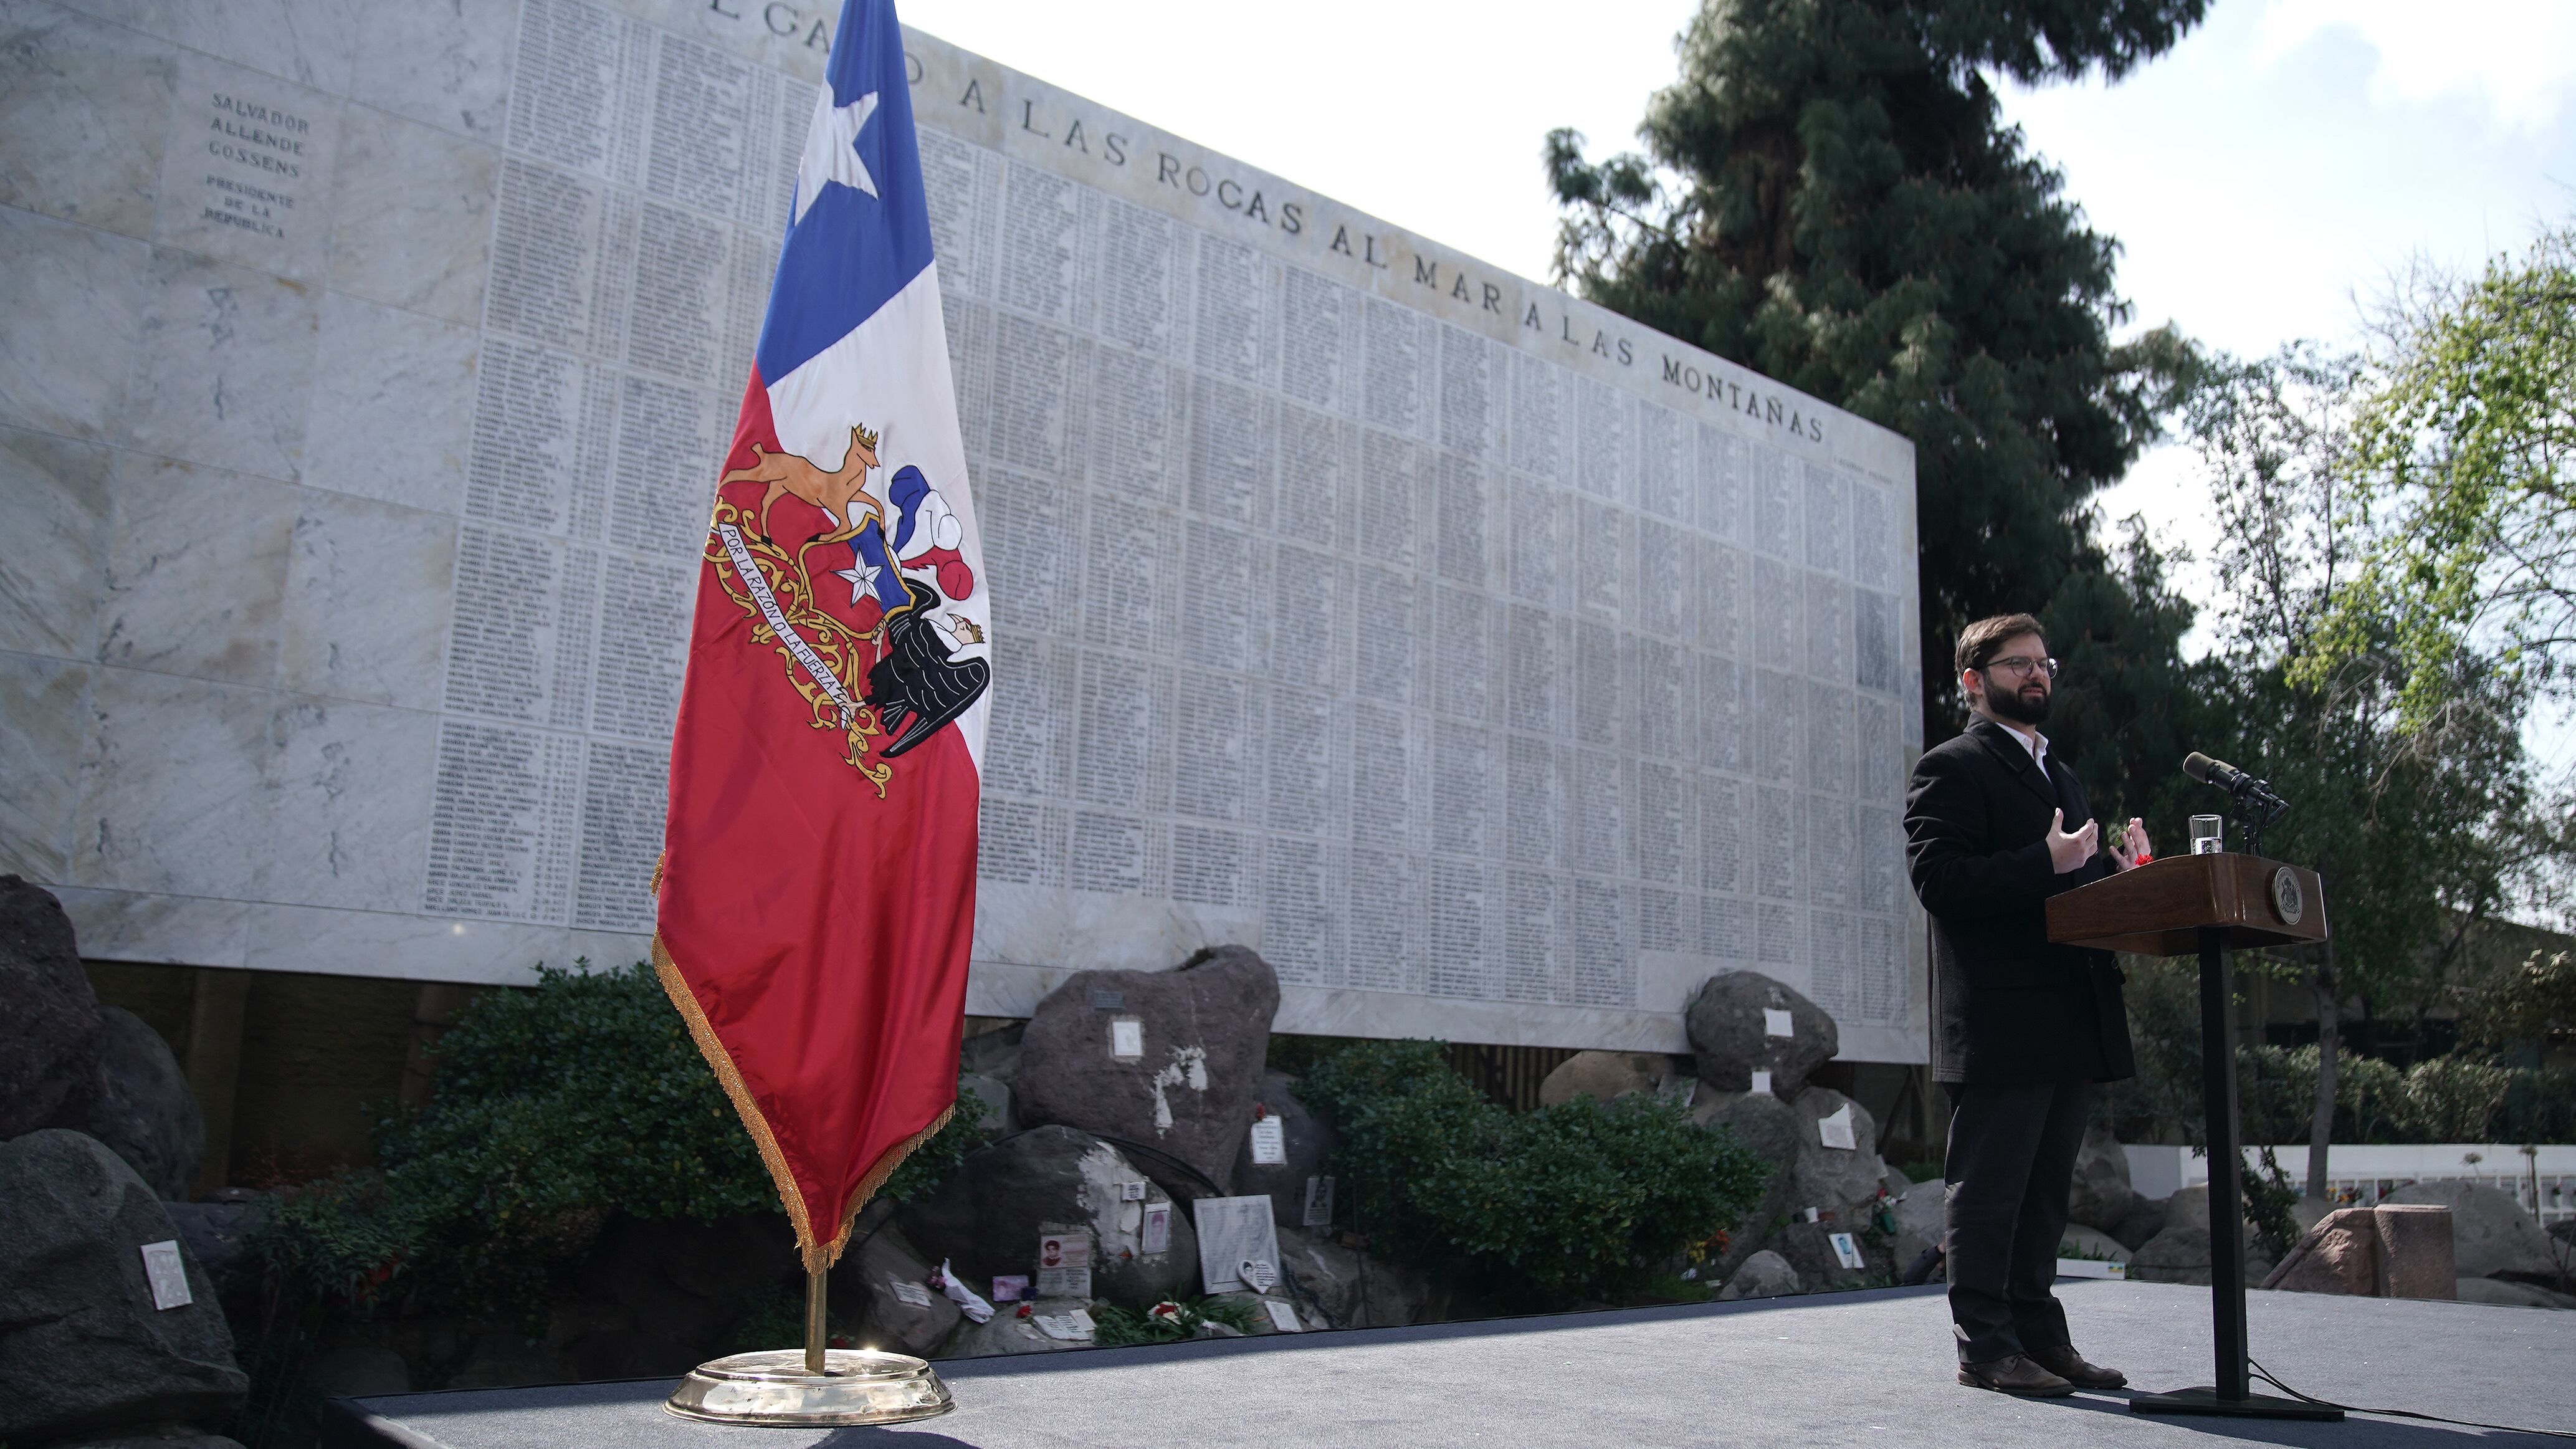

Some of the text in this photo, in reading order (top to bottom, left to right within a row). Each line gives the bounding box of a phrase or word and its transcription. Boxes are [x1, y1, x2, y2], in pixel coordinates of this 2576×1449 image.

[212, 93, 310, 135] SALVADOR
[210, 117, 304, 155] ALLENDE
[209, 140, 300, 178] GOSSENS
[206, 174, 294, 208] PRESIDENTE
[224, 196, 270, 217] DE LA
[958, 79, 986, 114] A
[1022, 98, 1128, 166] LAS
[1157, 152, 1302, 235] ROCAS
[1329, 225, 1388, 269] AL
[1414, 254, 1501, 314] MAR
[1525, 302, 1543, 332] A
[1562, 316, 1633, 366] LAS
[1662, 354, 1823, 443] MONTAÑAS
[722, 529, 836, 690] POR LA RAZÓN O LA FUERZA
